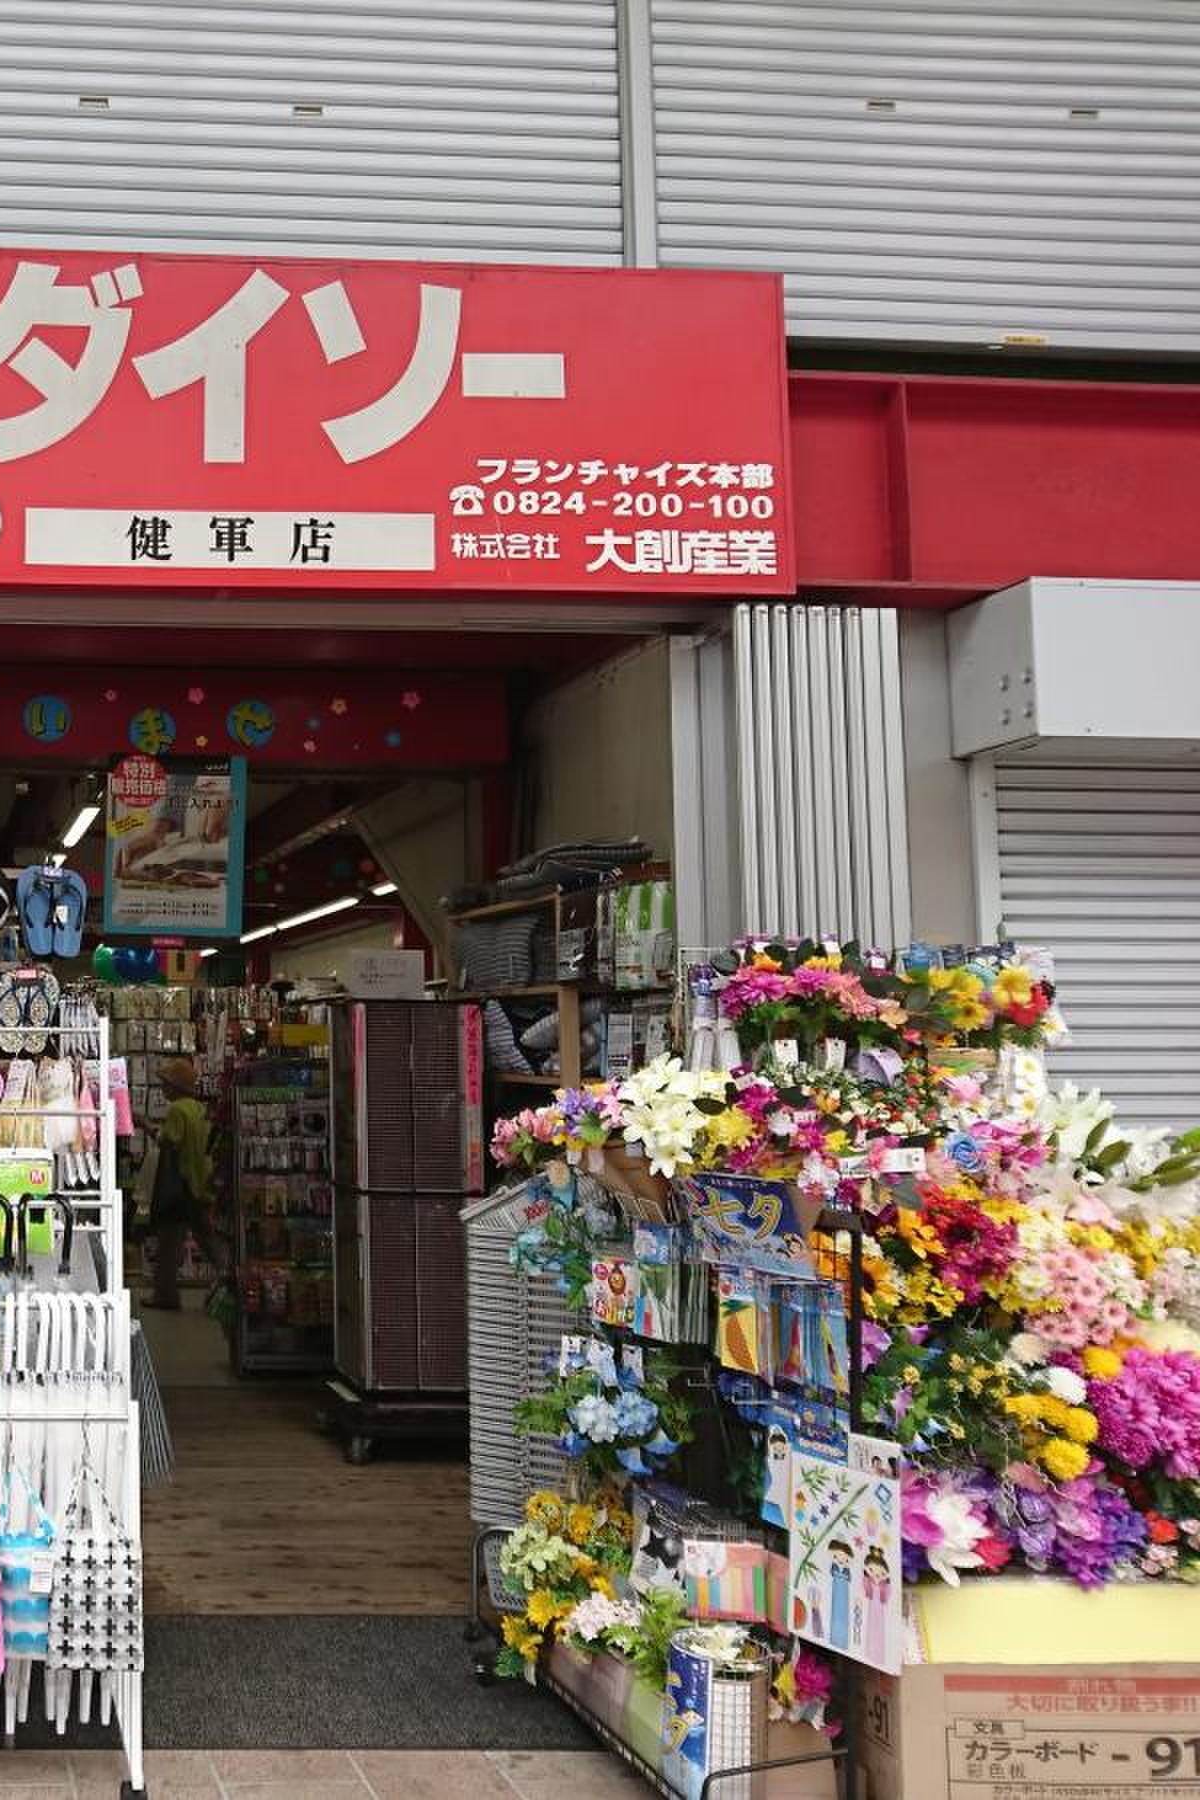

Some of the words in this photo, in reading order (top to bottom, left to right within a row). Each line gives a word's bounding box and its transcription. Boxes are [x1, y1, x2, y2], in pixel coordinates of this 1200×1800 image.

[477, 458, 774, 490] フランチャイズ本部
[493, 490, 774, 519] 0824-200-100
[126, 515, 336, 563] 健軍店
[451, 532, 560, 559] 株式会社
[585, 529, 777, 575] 大創産業
[965, 1740, 1098, 1764] カラーボード
